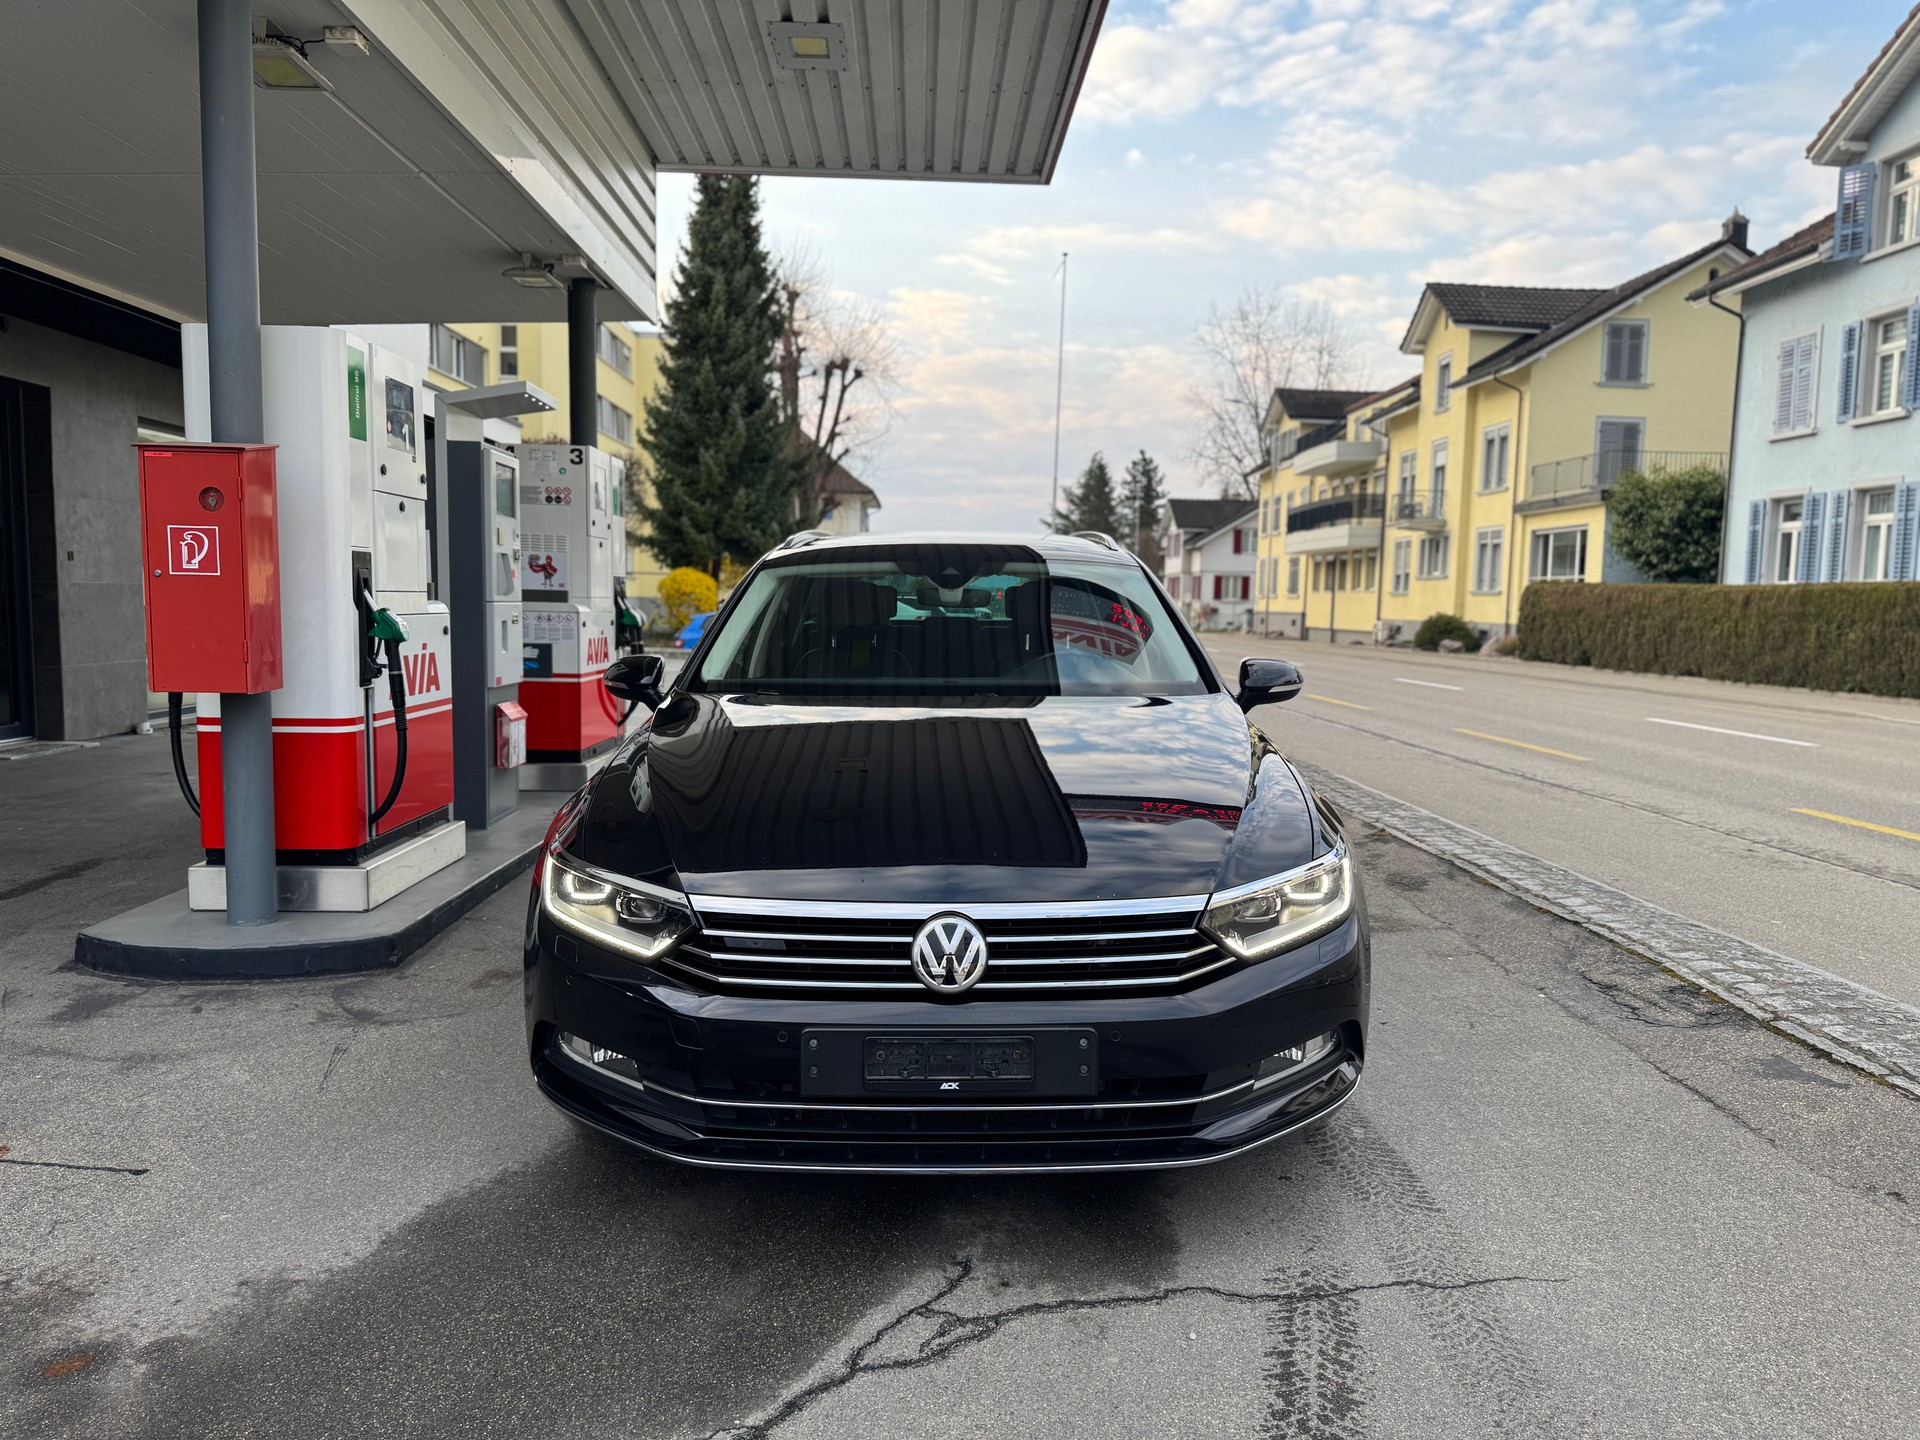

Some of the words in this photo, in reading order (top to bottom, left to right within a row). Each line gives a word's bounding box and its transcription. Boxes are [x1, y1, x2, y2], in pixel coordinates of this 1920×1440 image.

[402, 423, 410, 451] 1
[570, 448, 584, 465] 3
[588, 630, 609, 665] AVIA
[919, 922, 981, 986] VW
